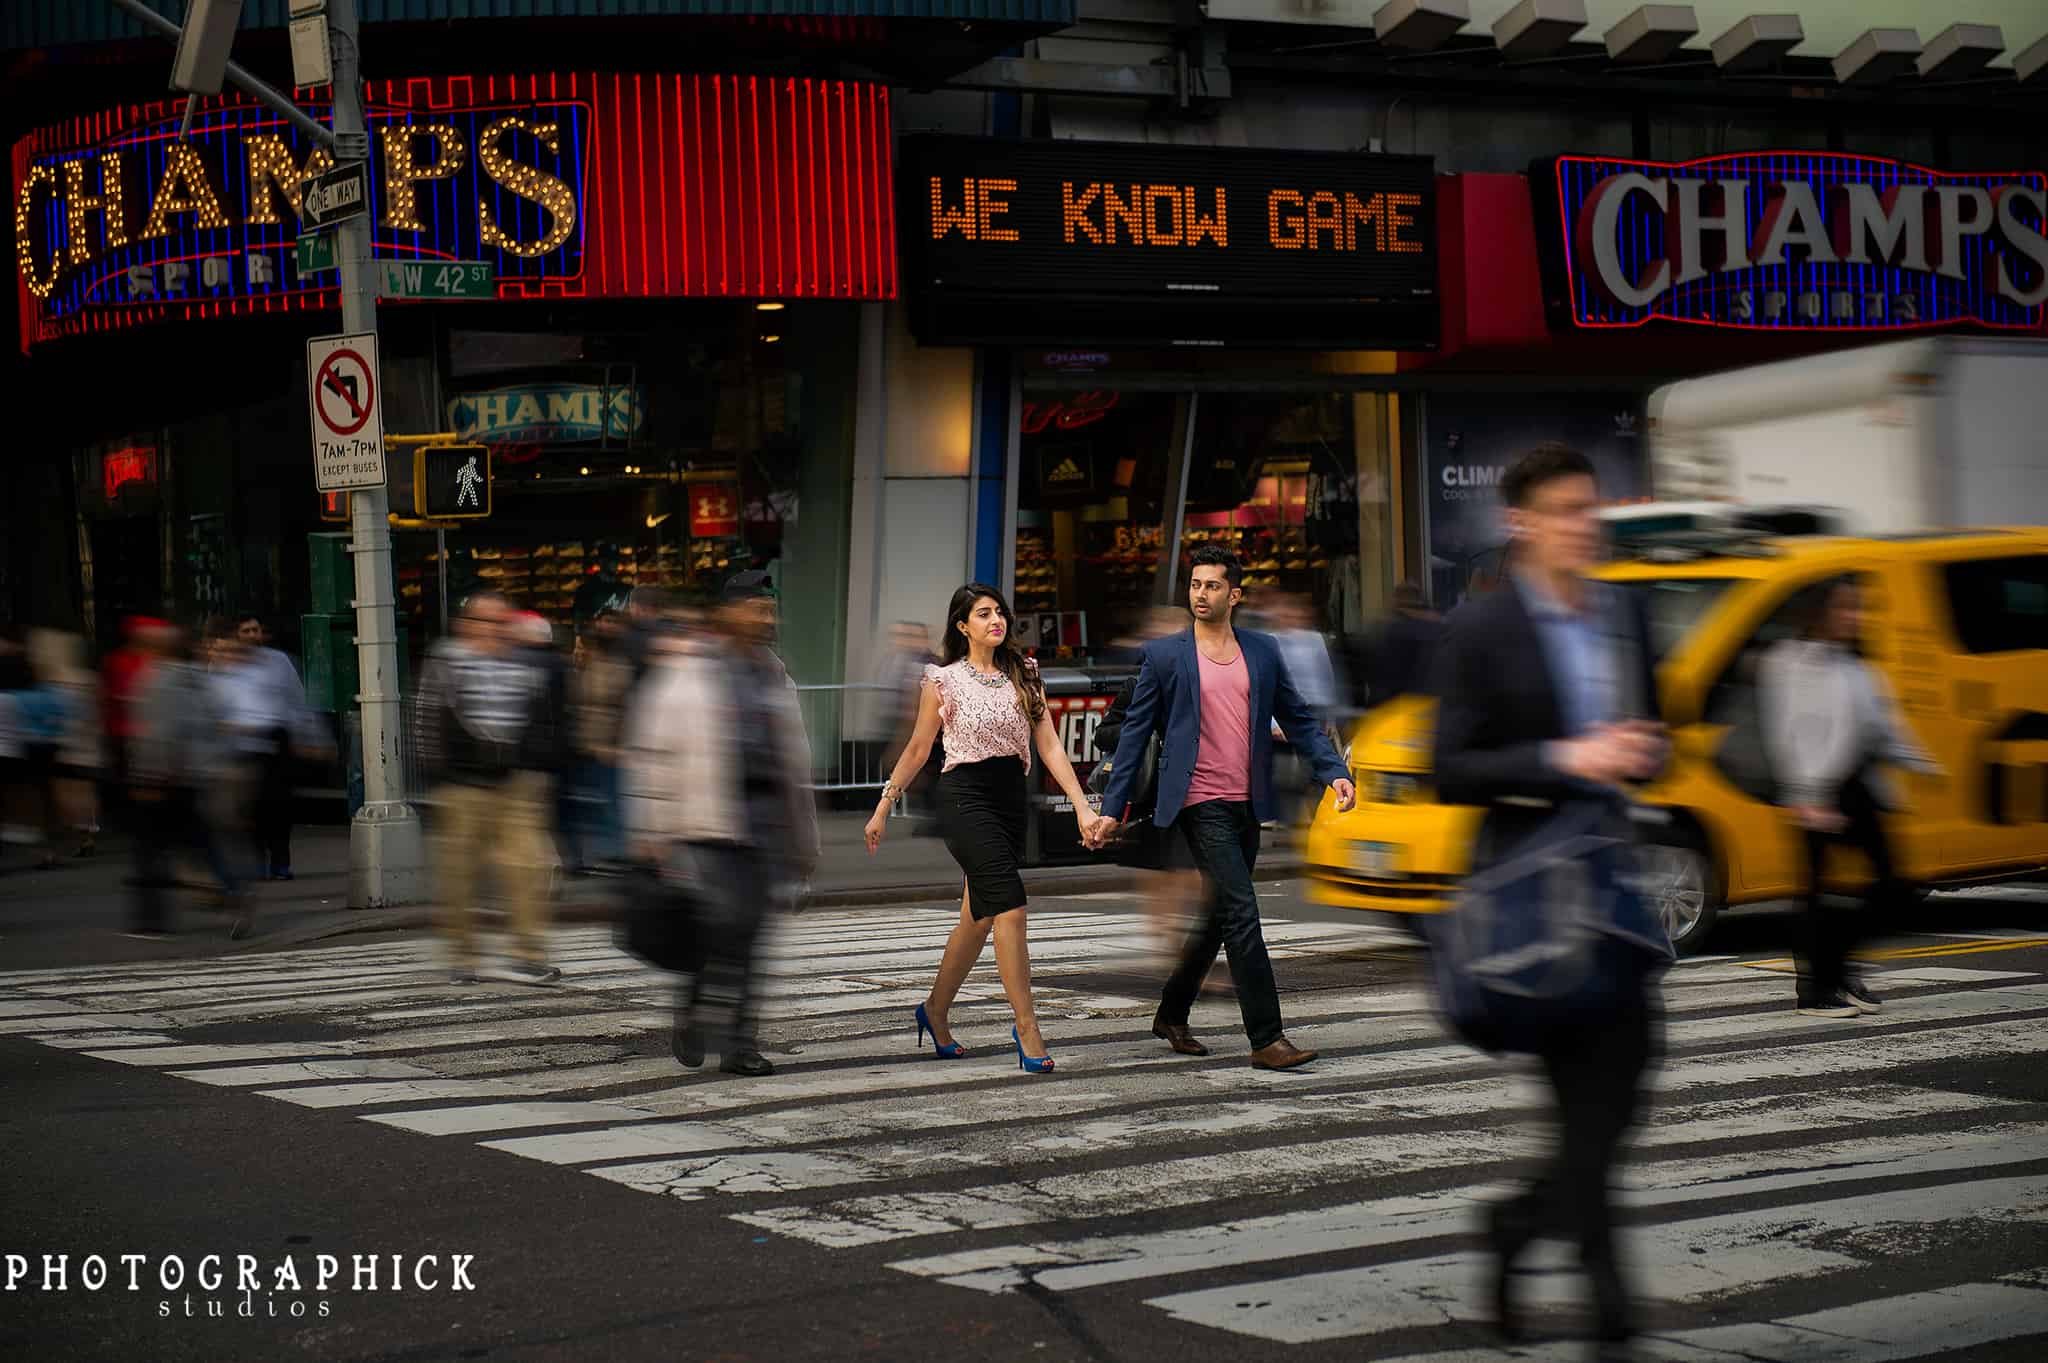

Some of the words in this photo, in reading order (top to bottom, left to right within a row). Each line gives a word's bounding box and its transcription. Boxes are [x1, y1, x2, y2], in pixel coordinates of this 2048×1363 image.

[16, 114, 577, 299] CHAMPS
[311, 186, 329, 213] ONE
[337, 180, 357, 201] WAY
[928, 175, 1021, 241] WE
[1062, 180, 1229, 249] KNOW
[1266, 188, 1424, 255] GAME
[304, 238, 314, 268] 7
[1591, 171, 2048, 307] CHAMPS
[128, 253, 313, 297] SPOR
[404, 264, 424, 294] W
[435, 264, 467, 294] 42
[471, 266, 489, 281] ST
[1731, 289, 1917, 320] SPORTS
[321, 440, 377, 459] 7AM-7PM
[322, 464, 350, 476] EXCEPT
[353, 462, 378, 473] BUSES
